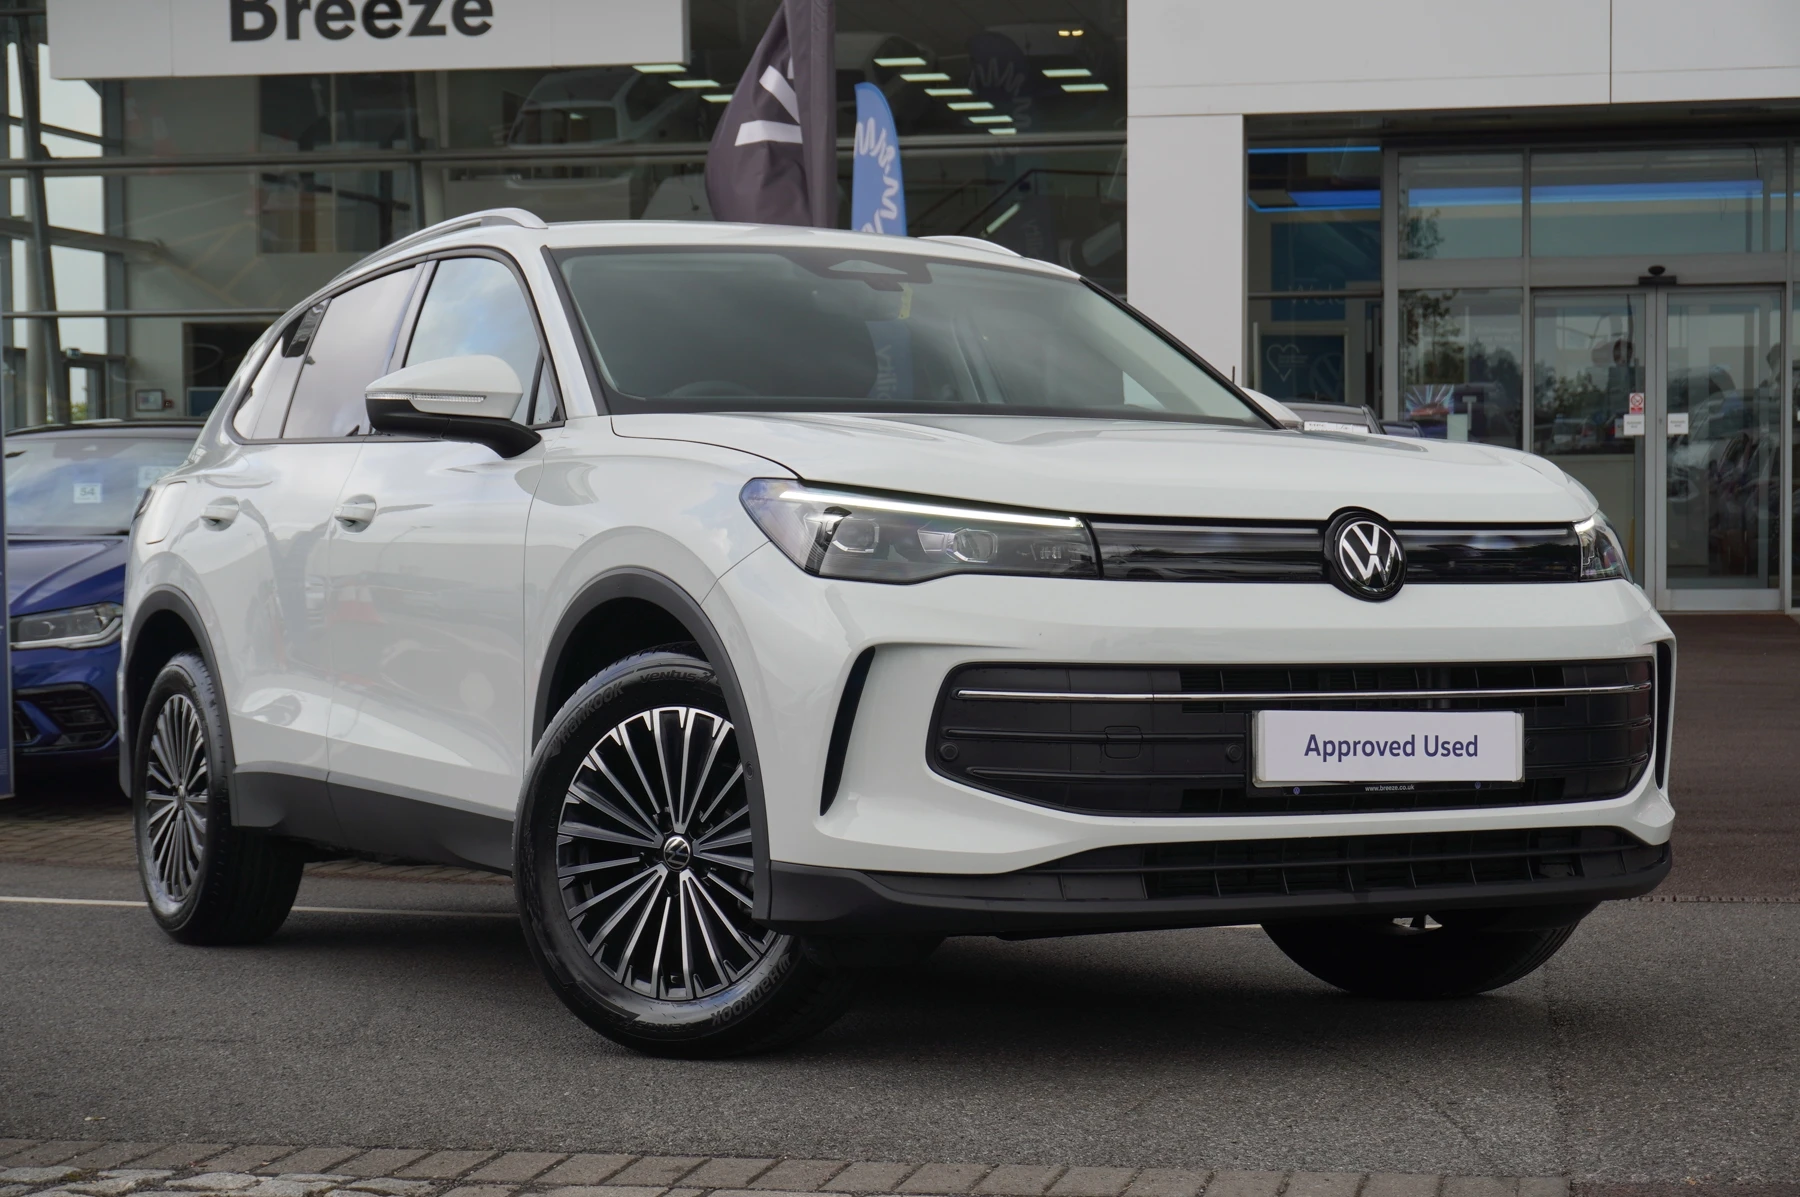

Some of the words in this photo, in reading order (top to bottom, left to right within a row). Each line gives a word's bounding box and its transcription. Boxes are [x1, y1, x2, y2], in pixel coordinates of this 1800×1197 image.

[230, 0, 494, 42] Breeze
[1304, 734, 1415, 762] Approved
[1424, 735, 1479, 757] Used
[1364, 784, 1416, 792] www.breeze.co.uk
